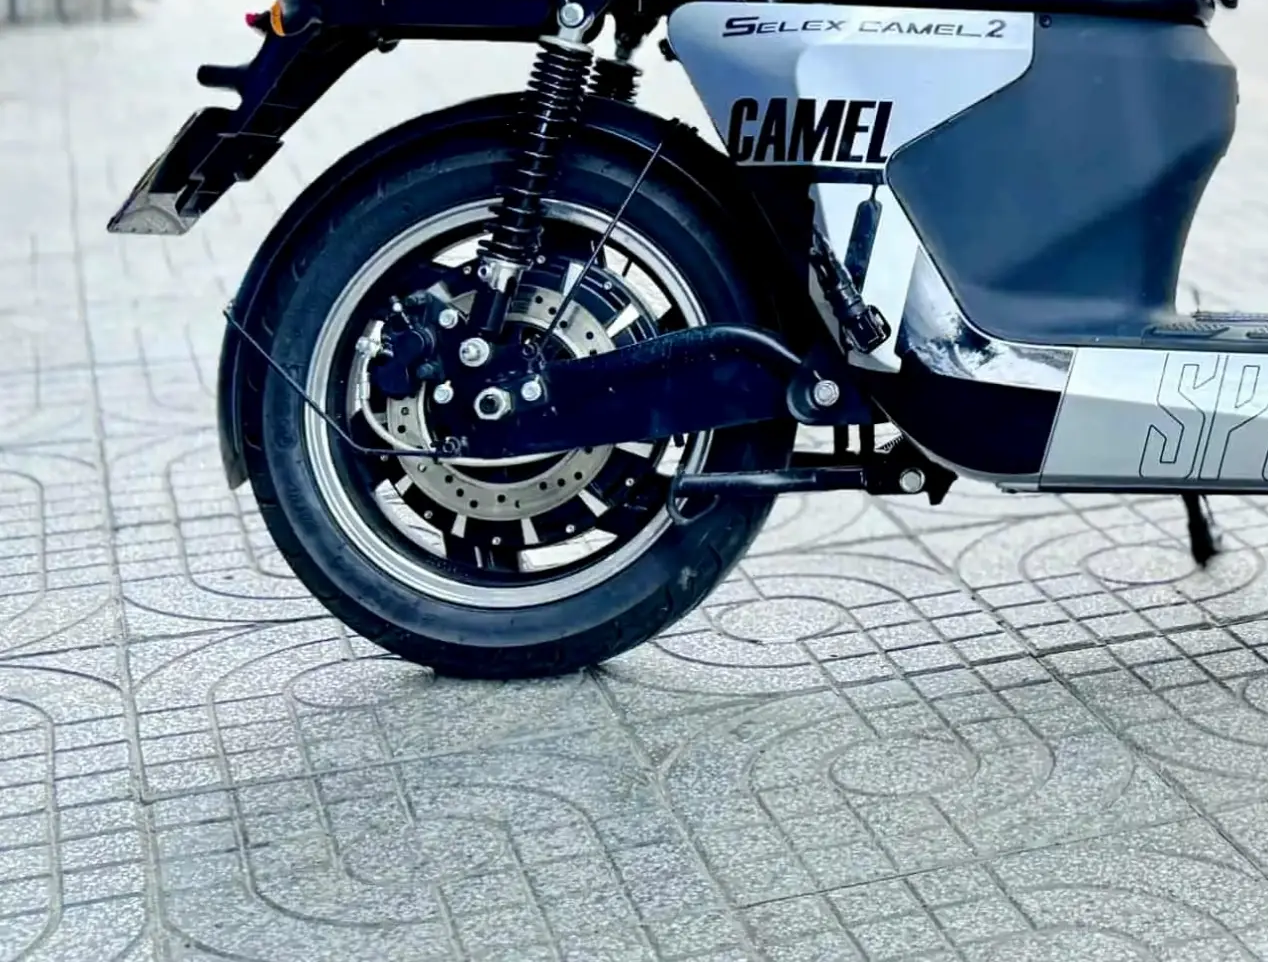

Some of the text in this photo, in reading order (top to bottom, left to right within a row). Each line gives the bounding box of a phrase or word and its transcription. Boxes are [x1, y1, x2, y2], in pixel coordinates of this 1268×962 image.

[722, 16, 846, 37] SELEX
[857, 19, 982, 38] CAMEL
[727, 96, 894, 164] CAMEL
